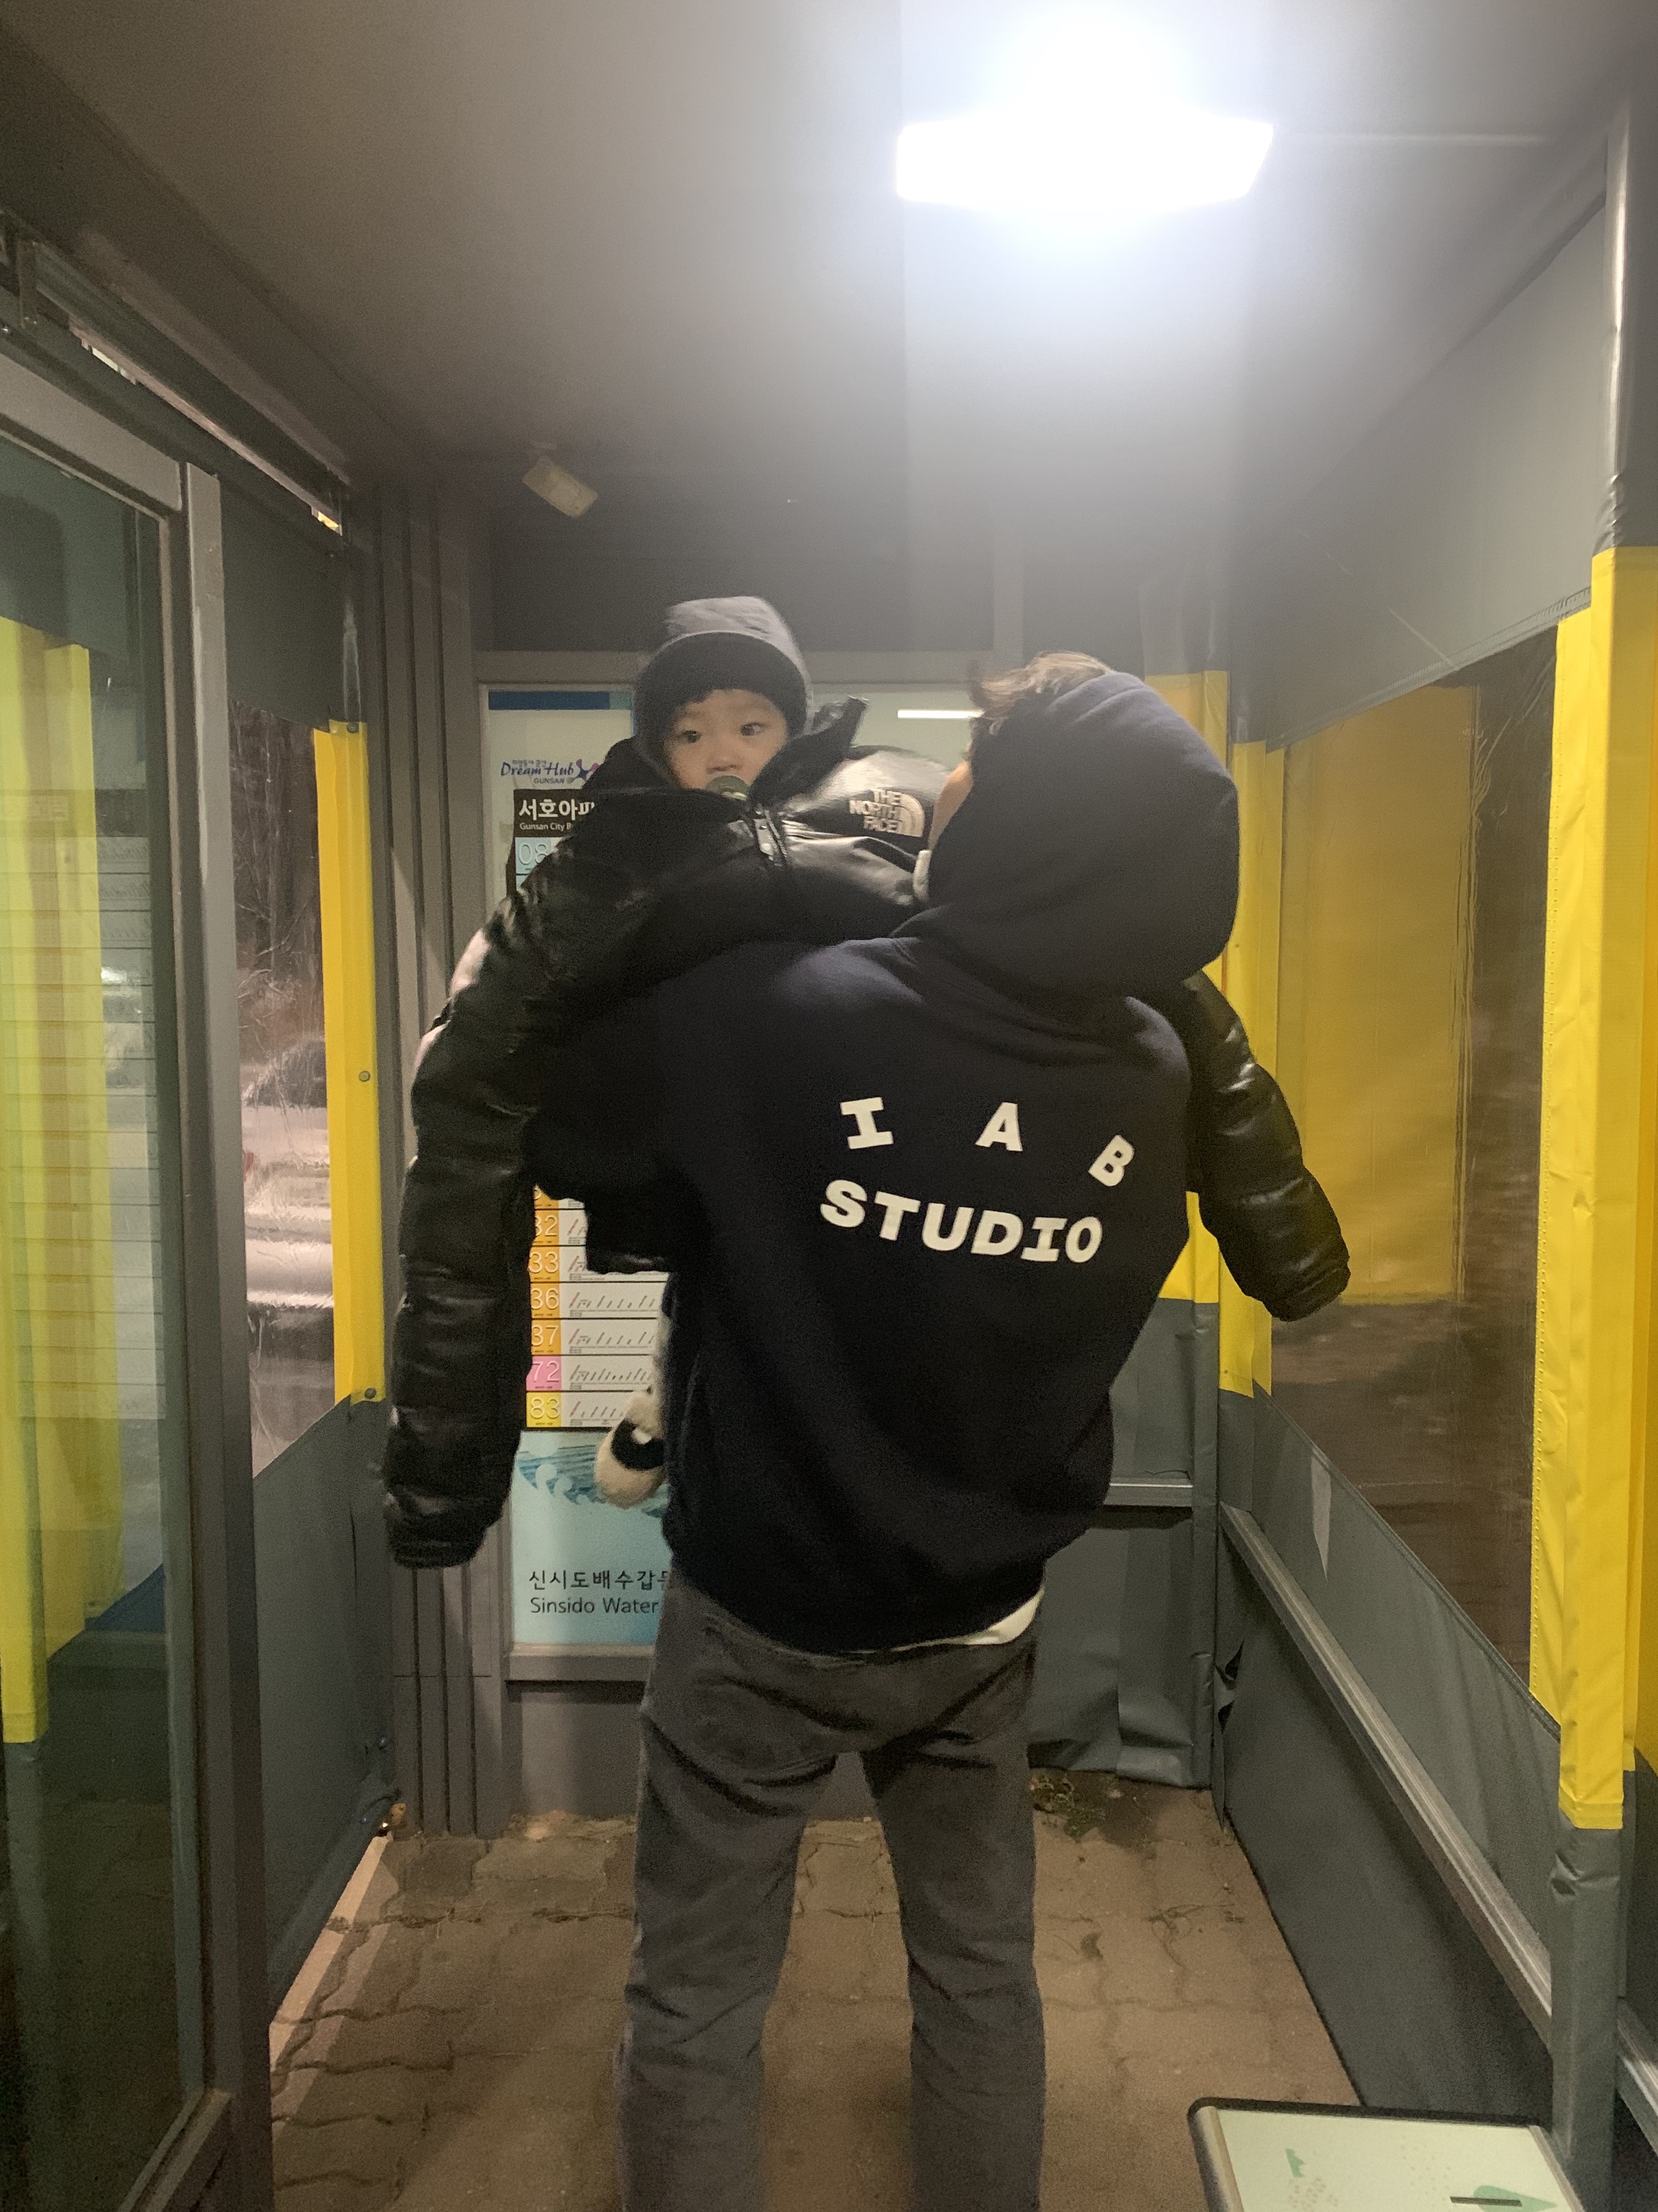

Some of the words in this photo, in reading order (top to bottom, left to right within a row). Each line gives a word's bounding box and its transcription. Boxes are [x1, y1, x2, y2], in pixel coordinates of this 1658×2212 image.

[500, 761, 541, 776] Dream
[544, 761, 574, 776] Hub
[871, 788, 901, 805] THE
[848, 799, 902, 820] NORTH
[550, 823, 565, 832] City
[862, 815, 899, 833] FACE
[820, 1180, 1103, 1263] STUDIO
[528, 1251, 559, 1274] 33
[531, 1287, 559, 1311] 36
[531, 1324, 559, 1347] 37
[533, 1360, 560, 1383] 72
[531, 1397, 561, 1420] 83
[531, 1596, 595, 1613] Sinsido
[602, 1597, 659, 1614] Water
